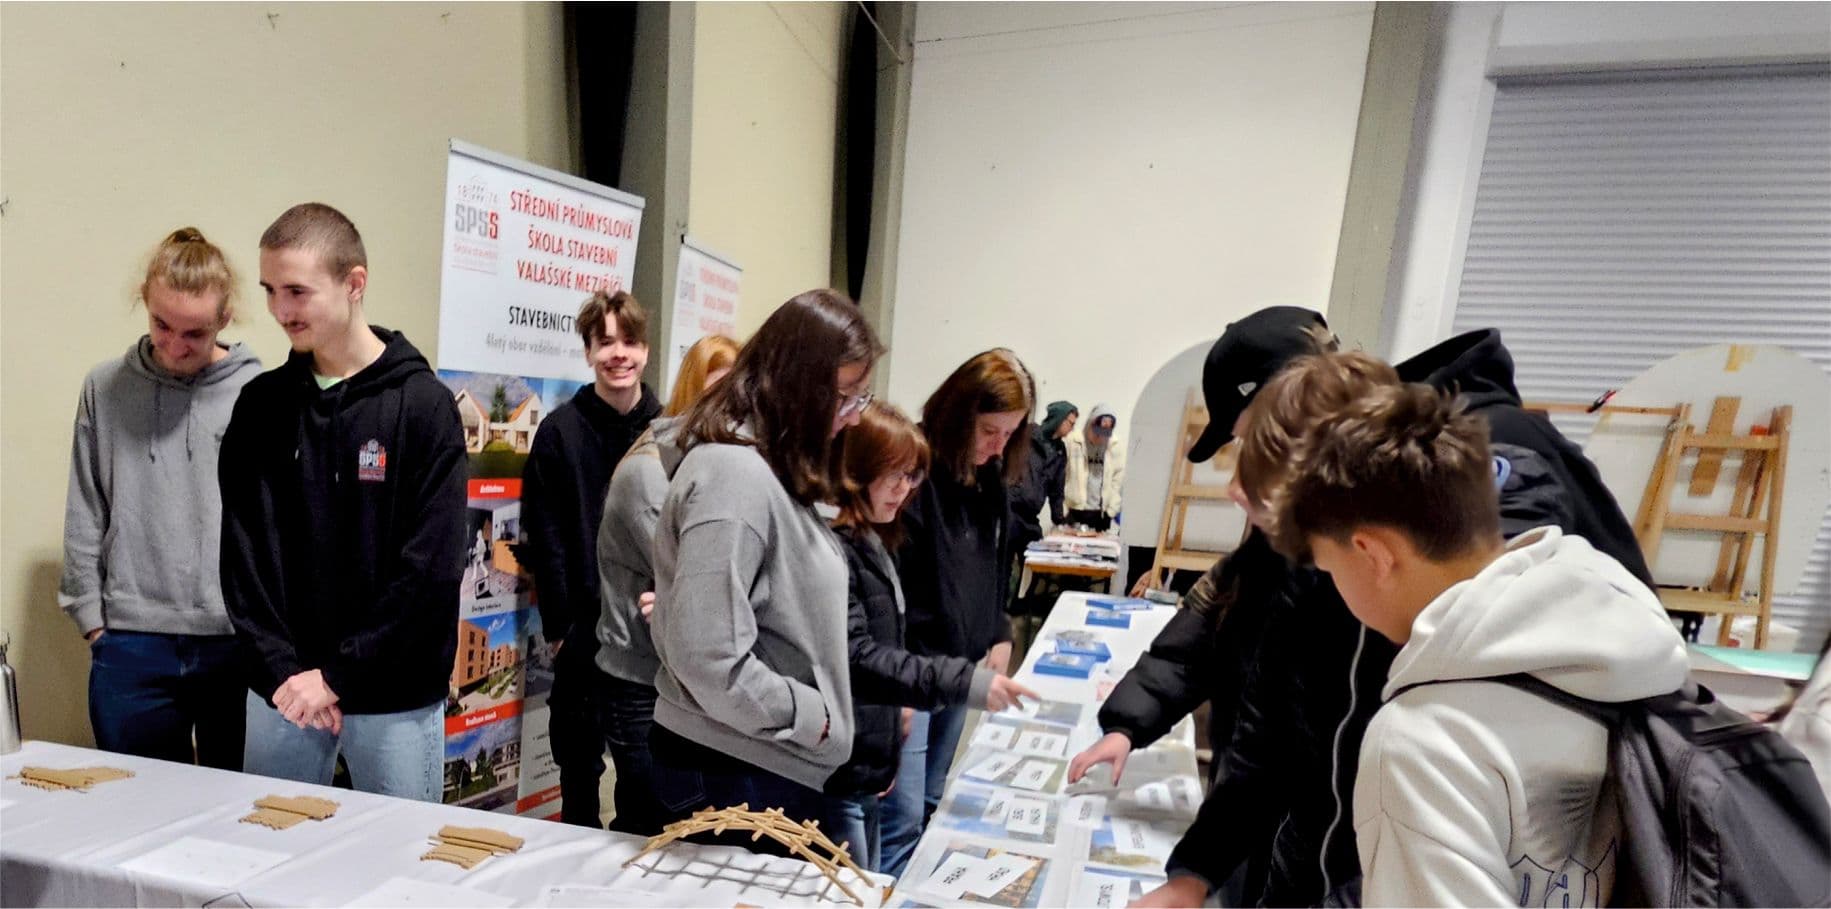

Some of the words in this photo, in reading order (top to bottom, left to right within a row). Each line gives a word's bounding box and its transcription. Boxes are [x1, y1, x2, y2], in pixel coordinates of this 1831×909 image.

[510, 189, 560, 222] STŘEDNÍ
[562, 203, 634, 240] PRŮMYSLOVÁ
[528, 223, 563, 256] ŠKOLA
[567, 239, 618, 268] STAVEBNÍ
[517, 260, 572, 289] VALAŠSKÉ
